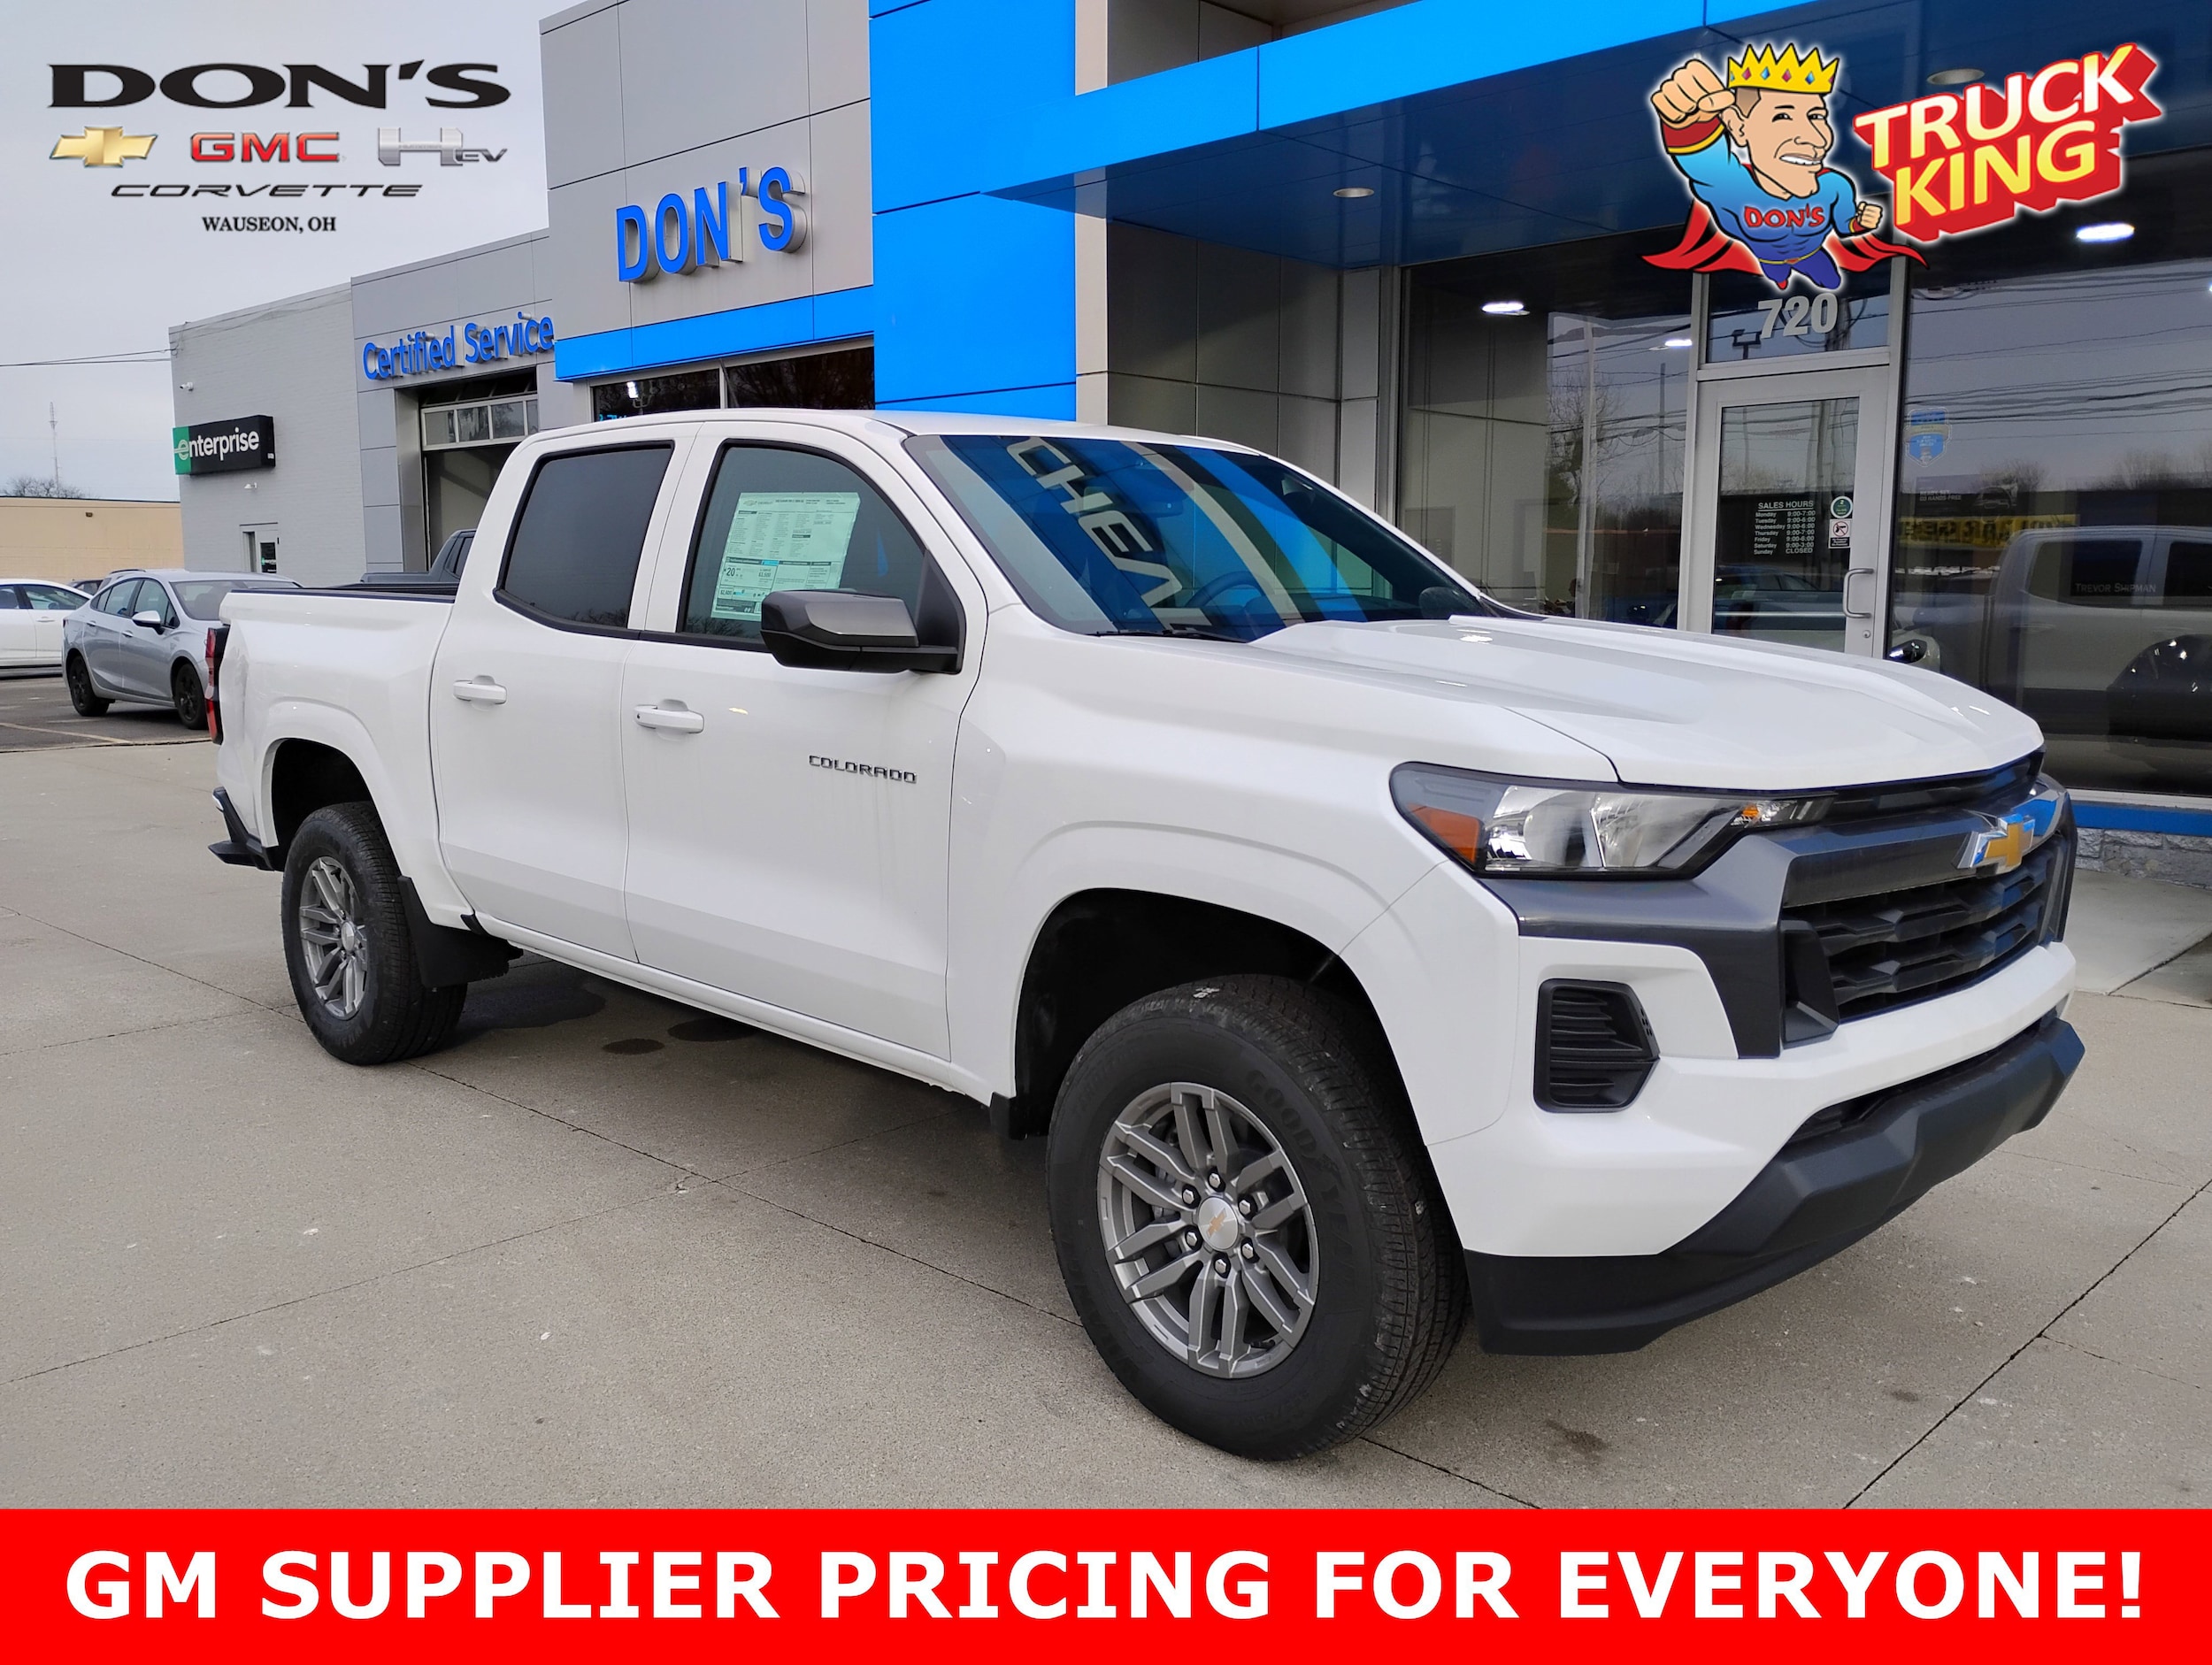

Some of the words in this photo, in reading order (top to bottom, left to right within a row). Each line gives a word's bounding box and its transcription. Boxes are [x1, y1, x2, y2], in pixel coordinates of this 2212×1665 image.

[616, 166, 806, 283] DON'S
[1757, 292, 1839, 339] 720
[363, 325, 457, 380] Certified
[464, 311, 555, 364] Service
[173, 426, 260, 461] enterprise
[1786, 500, 1814, 509] HOURS
[2075, 583, 2111, 593] TREVOR
[2114, 582, 2156, 593] SHIPMAN
[809, 755, 917, 784] COLORADO
